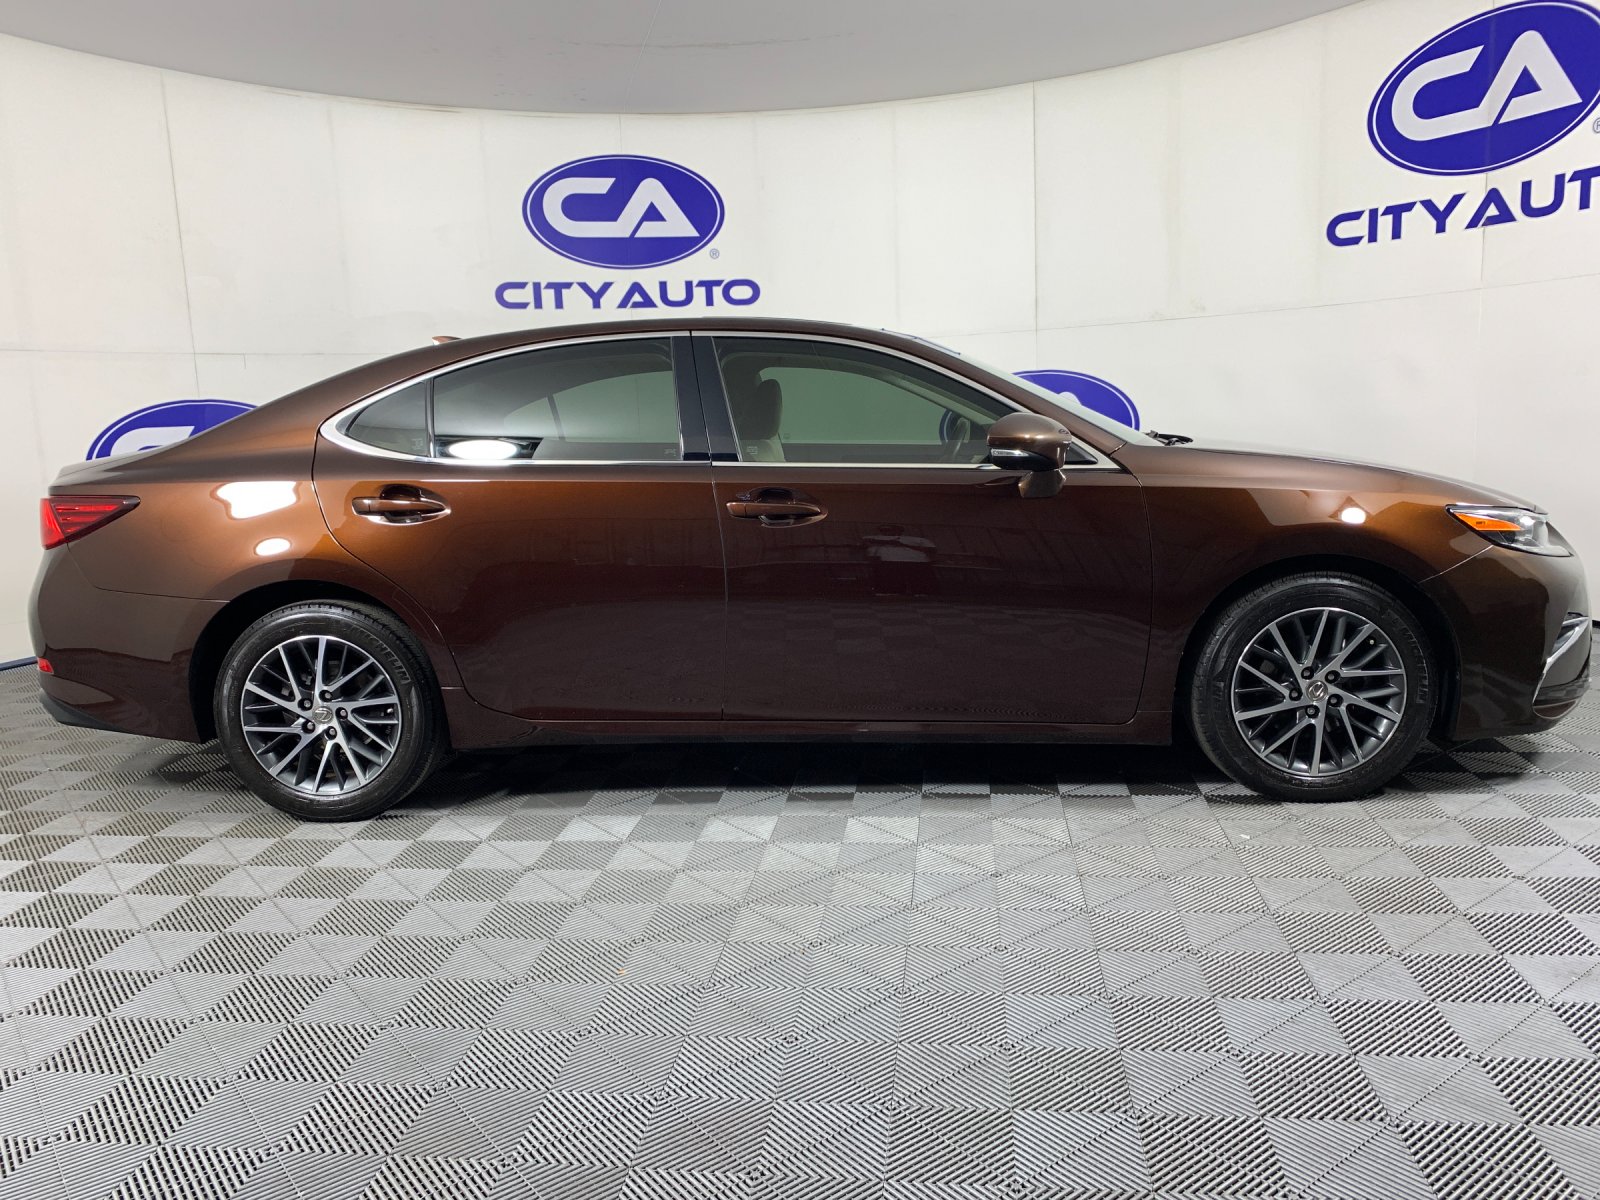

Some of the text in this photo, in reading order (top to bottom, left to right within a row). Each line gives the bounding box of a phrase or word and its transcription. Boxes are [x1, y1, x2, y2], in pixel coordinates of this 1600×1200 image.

[1391, 29, 1583, 142] CA
[542, 177, 701, 238] CA
[1326, 165, 1600, 247] CITY AUT
[495, 279, 761, 309] CITY AUTO
